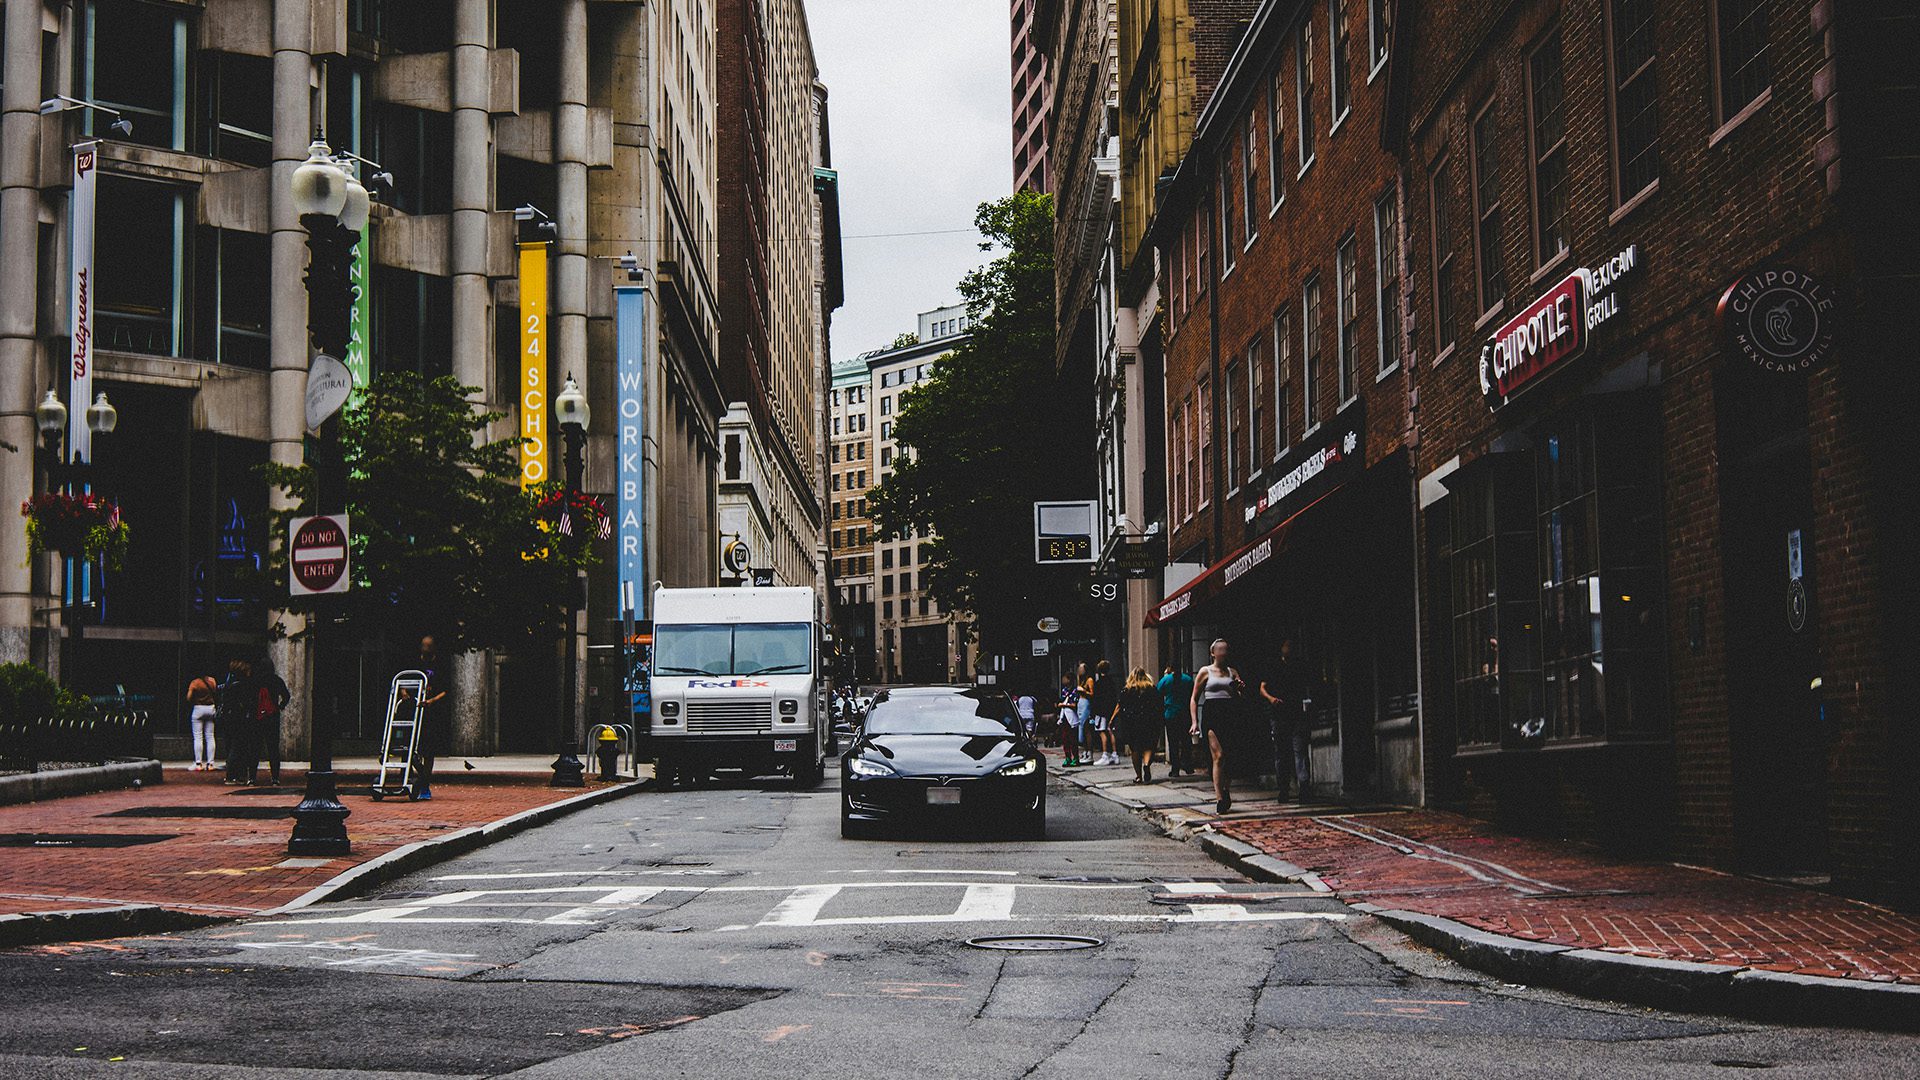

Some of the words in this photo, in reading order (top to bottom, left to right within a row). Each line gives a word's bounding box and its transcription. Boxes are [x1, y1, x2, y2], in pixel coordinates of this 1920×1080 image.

[1585, 244, 1637, 299] MEXICAN
[1733, 270, 1833, 313] CHIPOTLE
[74, 267, 91, 381] Walgreens
[1587, 291, 1619, 330] GRILL
[526, 314, 541, 357] 24
[1493, 293, 1571, 380] CHIPOTLE
[1737, 334, 1797, 372] MEXICAN
[1800, 334, 1833, 368] GRILL
[523, 367, 544, 494] SCHOO
[619, 371, 642, 556] WORKBAR
[301, 531, 315, 545] DO
[319, 529, 337, 544] NOT
[303, 563, 335, 577] ENTER
[1090, 583, 1118, 601] sg
[687, 679, 770, 688] FedEx
